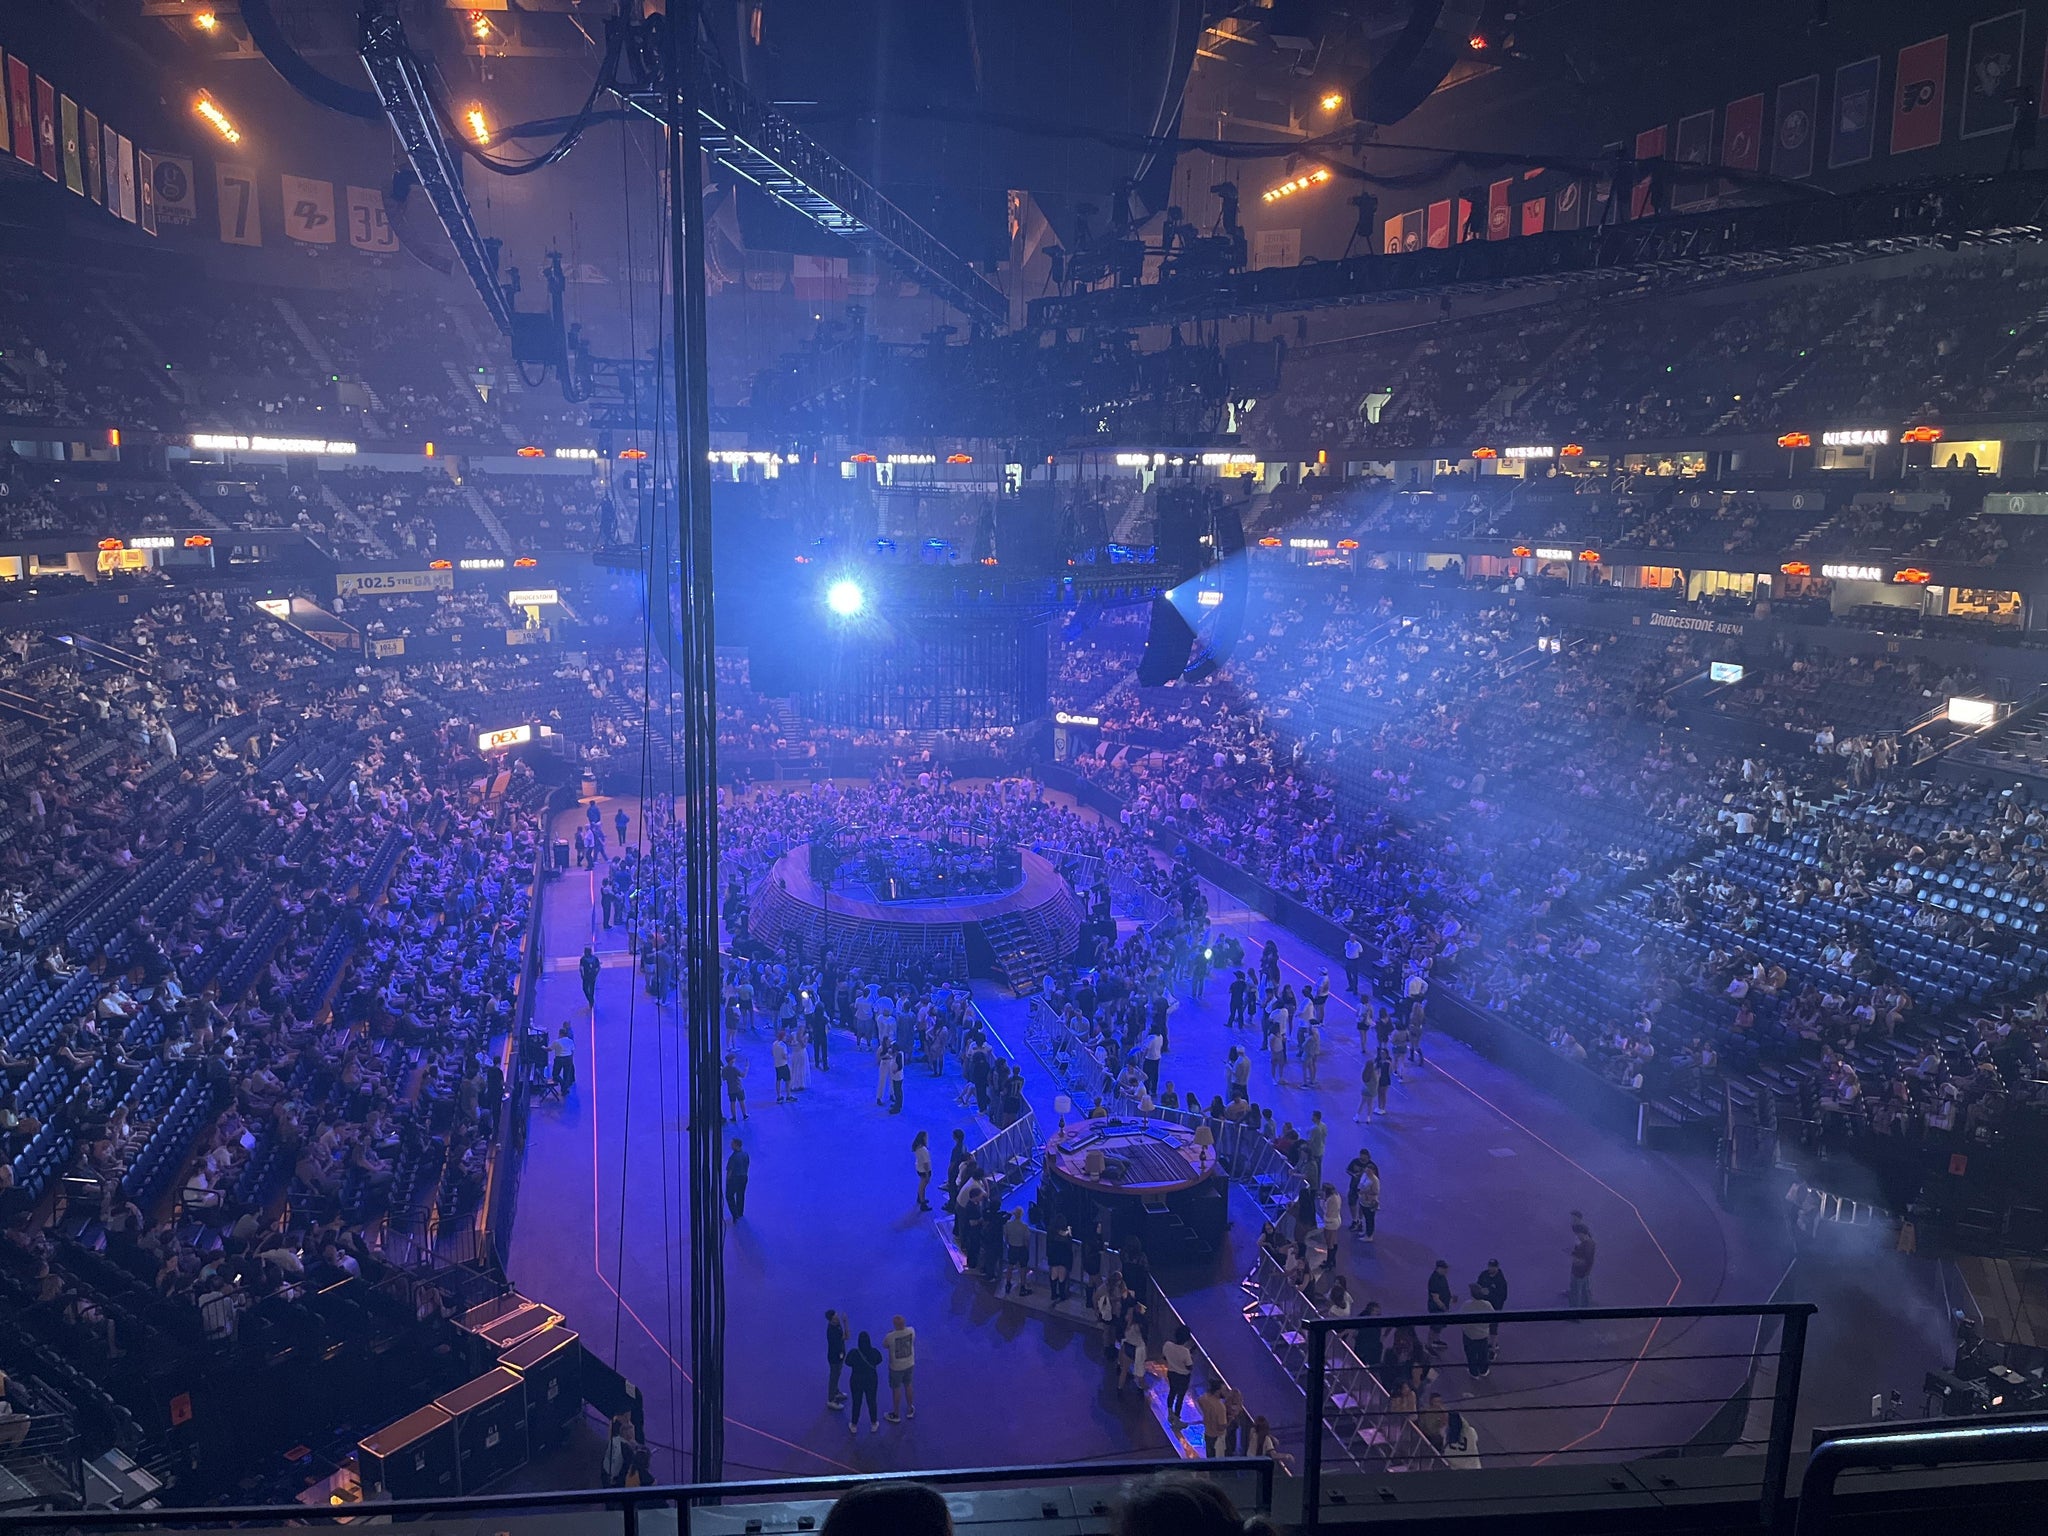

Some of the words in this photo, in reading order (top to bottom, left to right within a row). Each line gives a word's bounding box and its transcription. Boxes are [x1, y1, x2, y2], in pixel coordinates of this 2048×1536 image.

[223, 177, 250, 238] 7
[353, 206, 393, 246] 35
[1823, 430, 1887, 445] NISSAN
[556, 448, 606, 459] NISSA
[888, 454, 935, 464] NISSAN
[1505, 447, 1553, 458] NISSAN
[131, 537, 174, 548] NISSAN
[1290, 538, 1328, 549] NISSAN
[1536, 548, 1572, 560] NISSAN
[460, 559, 504, 569] NISSAN
[1822, 564, 1880, 581] NISSAN
[356, 576, 395, 589] 102.5
[413, 574, 452, 586] GAME
[1649, 612, 1714, 632] BRIDGESTONE
[1715, 623, 1744, 636] ARENA
[491, 729, 519, 746] DEX
